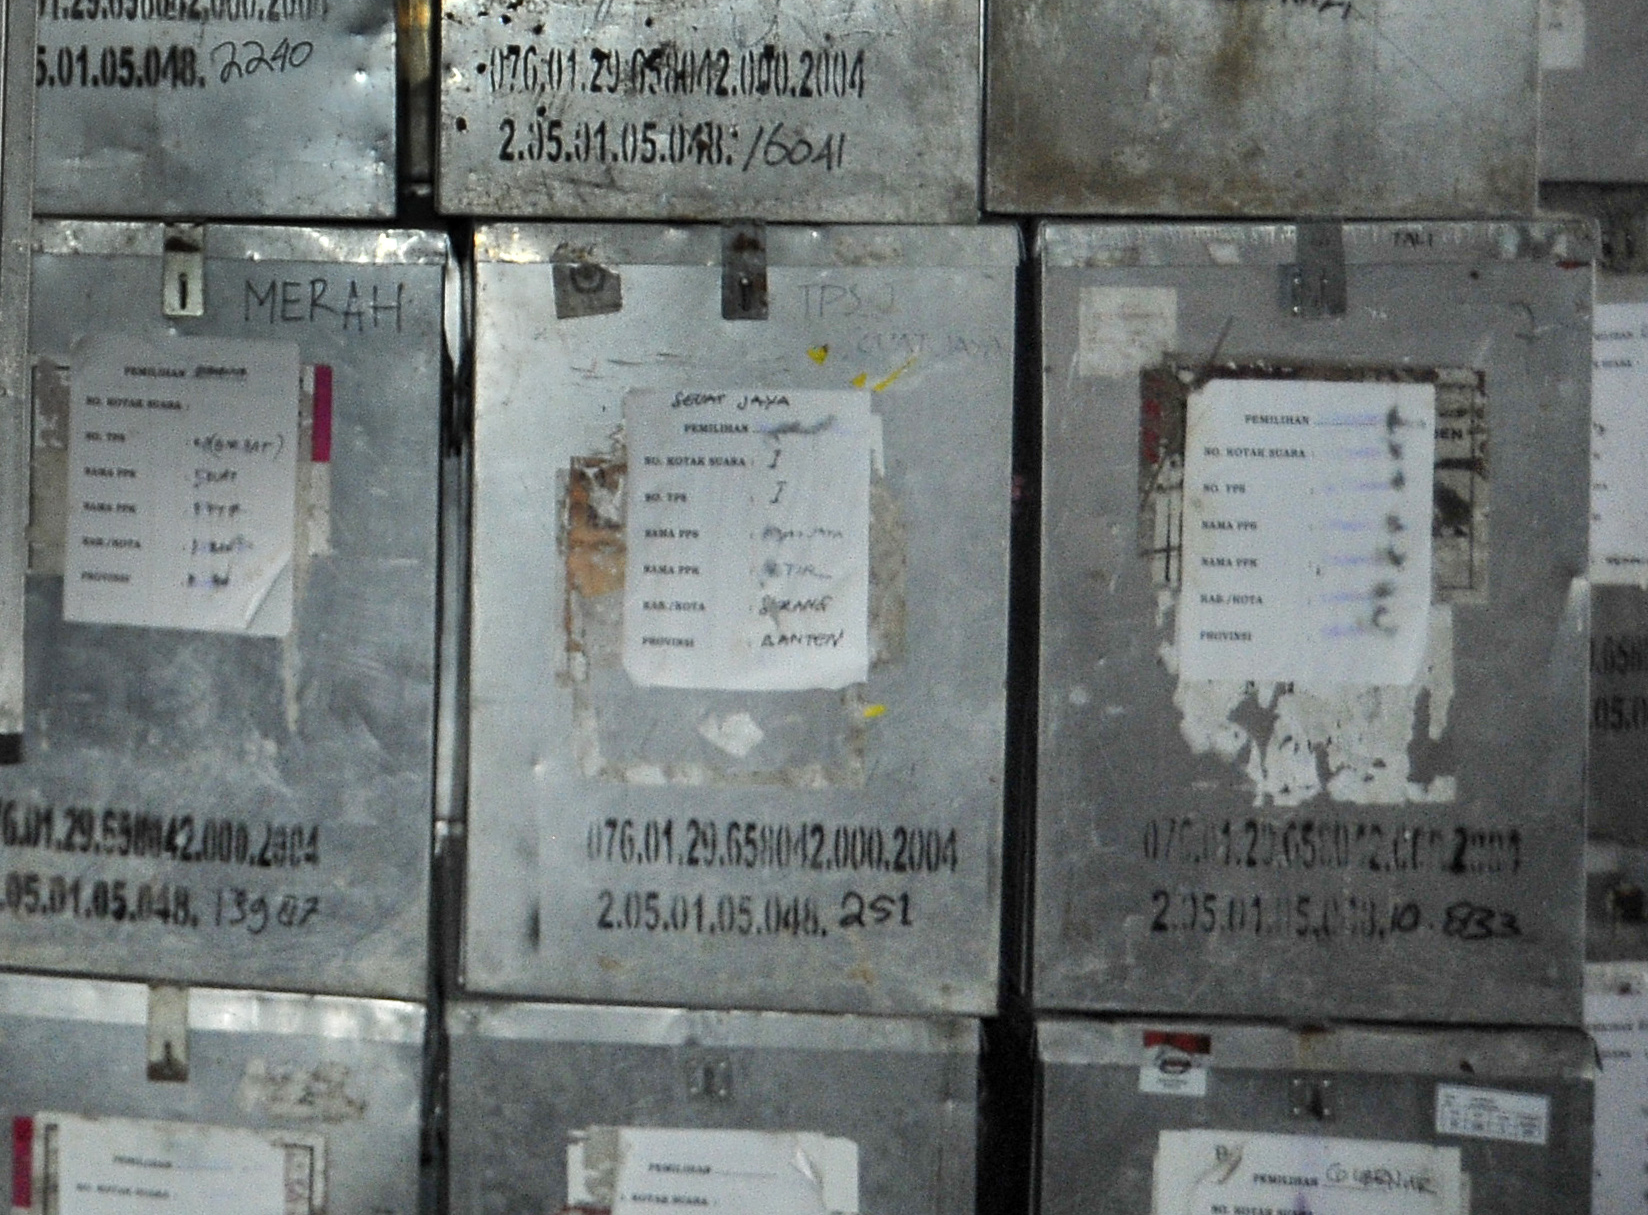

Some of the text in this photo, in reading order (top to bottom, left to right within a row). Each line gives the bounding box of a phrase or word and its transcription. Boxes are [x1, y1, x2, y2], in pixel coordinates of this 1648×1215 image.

[243, 277, 406, 333] MERAH
[1243, 413, 1310, 425] PEMILIHAN
[684, 423, 749, 434] PEMILIHAN
[1225, 447, 1266, 459] KOTAK
[1269, 448, 1307, 459] SUARA
[666, 456, 705, 467] KOTAK
[709, 456, 747, 467] SUARA
[1201, 520, 1258, 531] NAMA PPS
[1200, 557, 1258, 568] NAMA PPK
